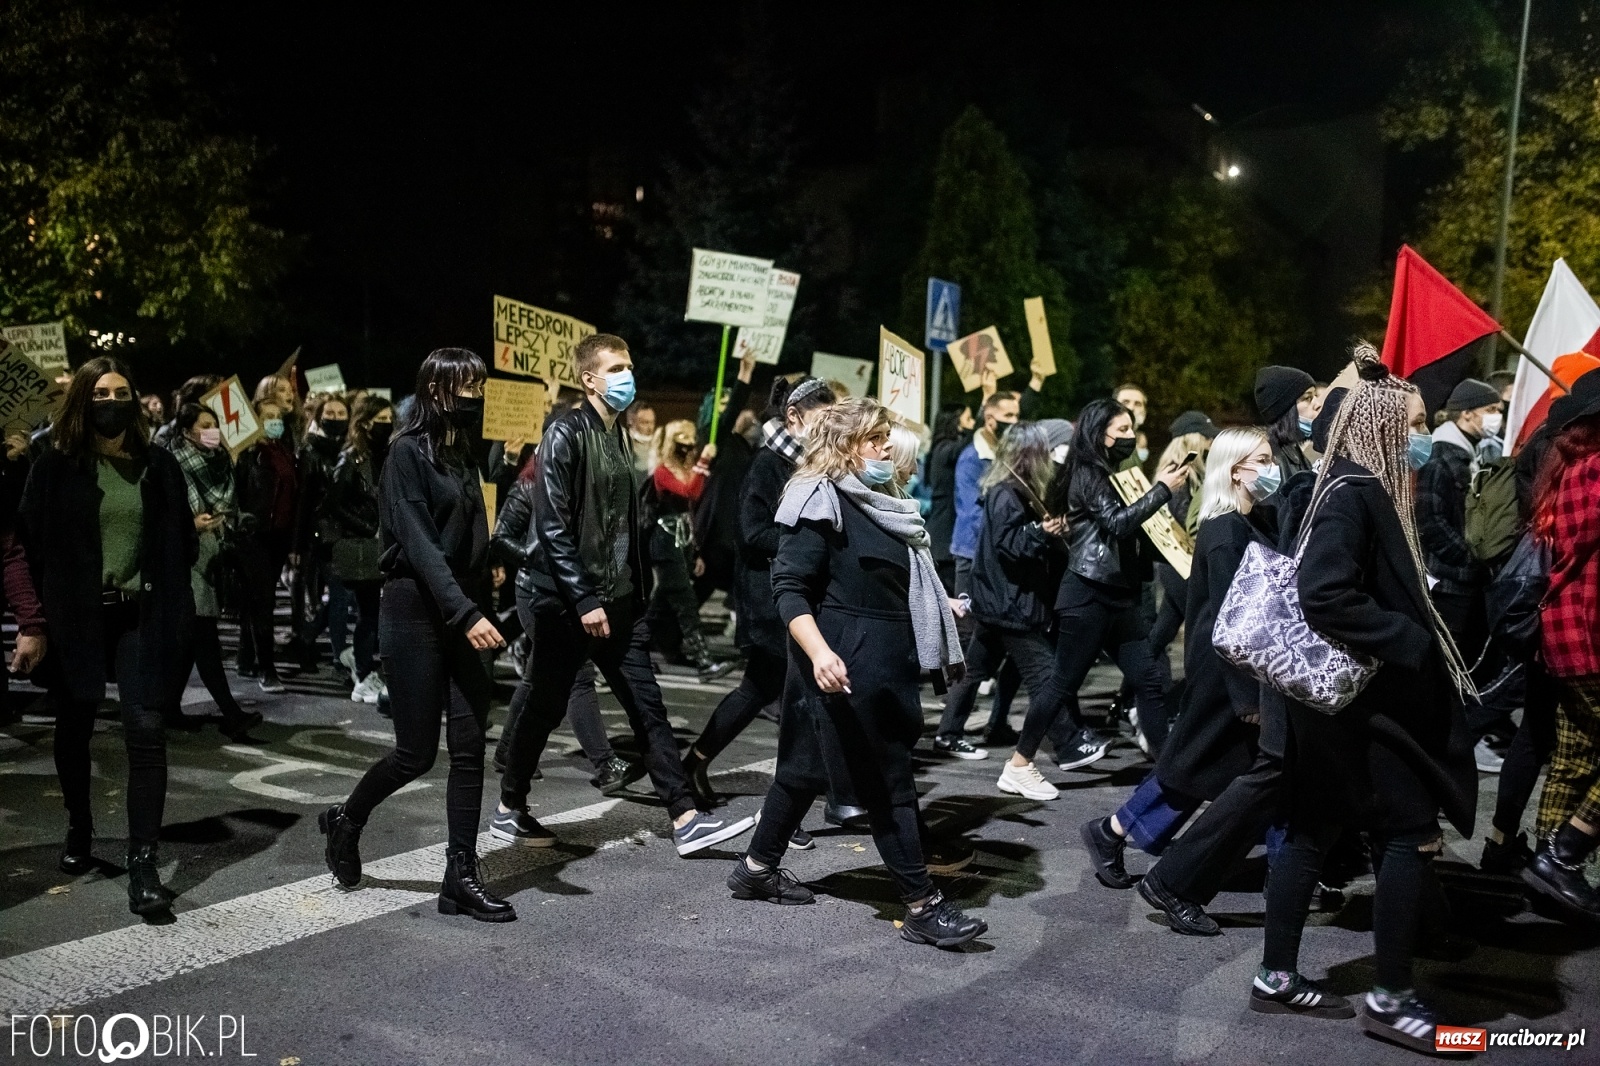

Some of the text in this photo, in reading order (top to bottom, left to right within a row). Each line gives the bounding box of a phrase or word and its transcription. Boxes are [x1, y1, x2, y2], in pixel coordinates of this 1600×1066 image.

[41, 326, 57, 336] NIE
[497, 301, 573, 340] MEFEDRON
[495, 321, 550, 355] LEPSZY
[513, 350, 541, 375] NIŻ
